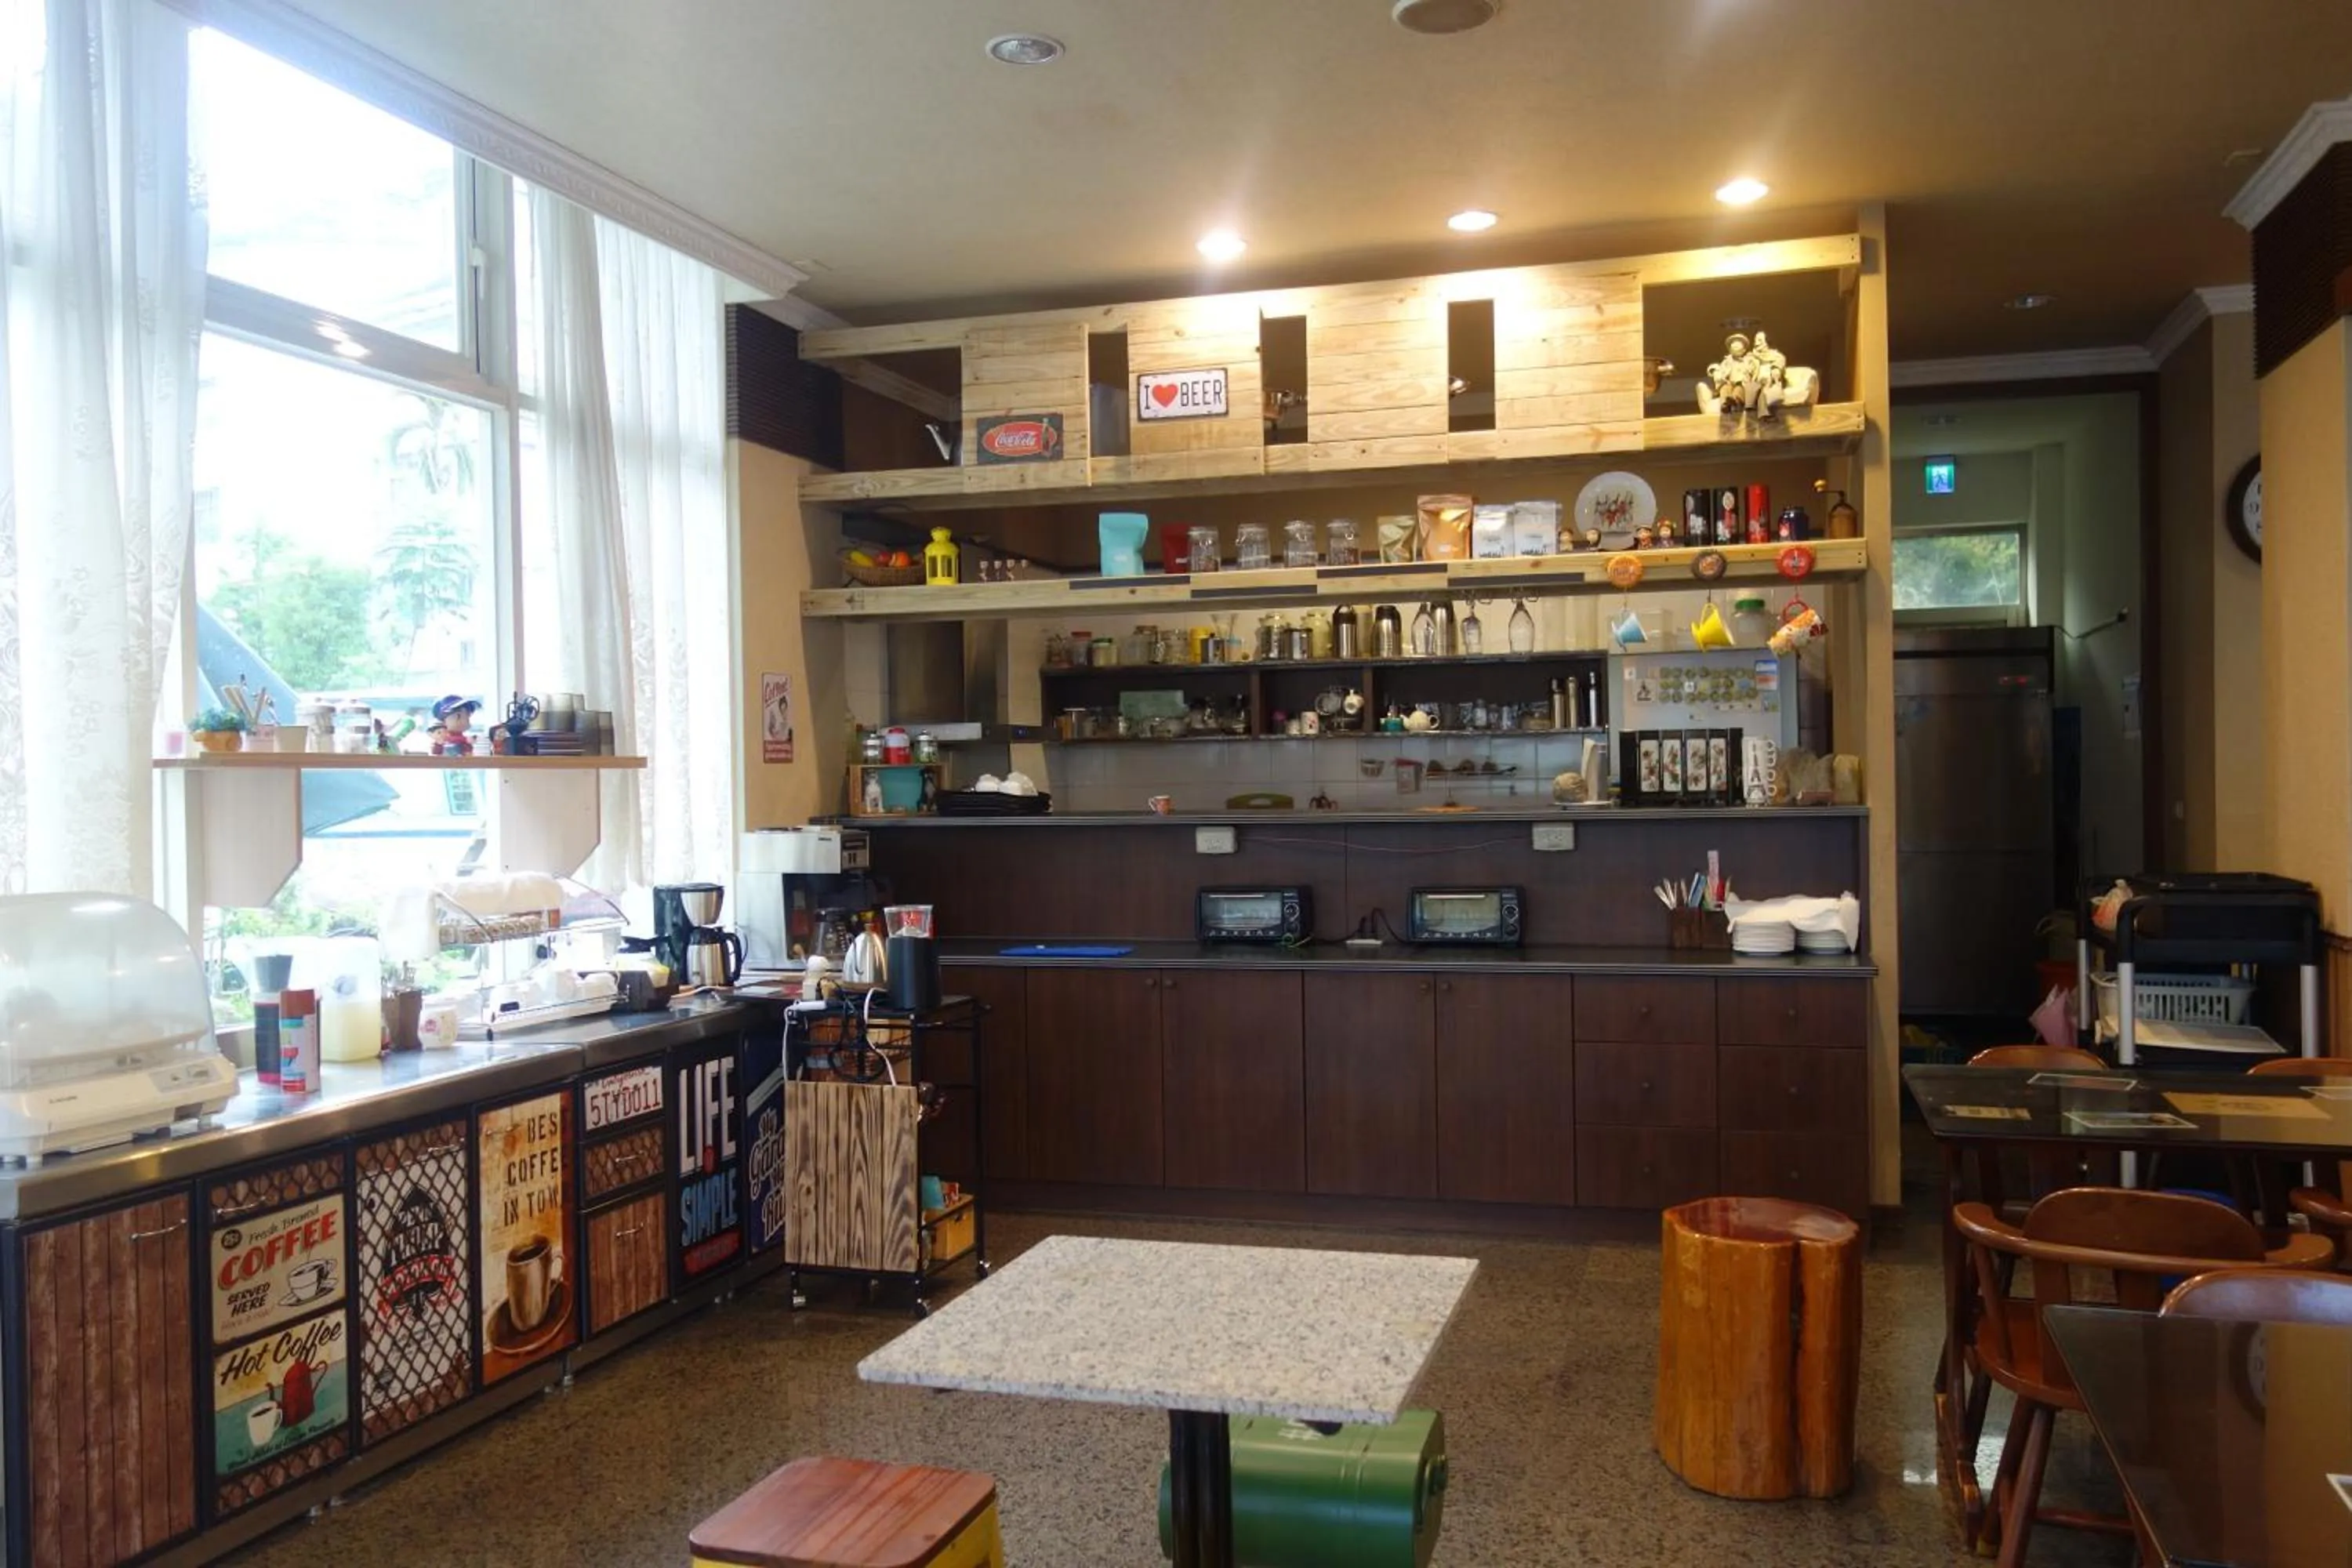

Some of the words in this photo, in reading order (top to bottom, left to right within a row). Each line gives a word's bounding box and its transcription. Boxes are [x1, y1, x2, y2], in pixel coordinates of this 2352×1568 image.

[1145, 384, 1150, 410] I
[1180, 379, 1222, 407] BEER
[679, 1056, 736, 1175] LIFE
[503, 1196, 519, 1227] IN
[681, 1167, 738, 1247] SIMPLE
[218, 1208, 338, 1290] COFFEE
[227, 1282, 271, 1306] SERVED
[230, 1294, 267, 1318] HERE
[220, 1343, 270, 1386] Hot
[273, 1319, 342, 1366] Coffee
